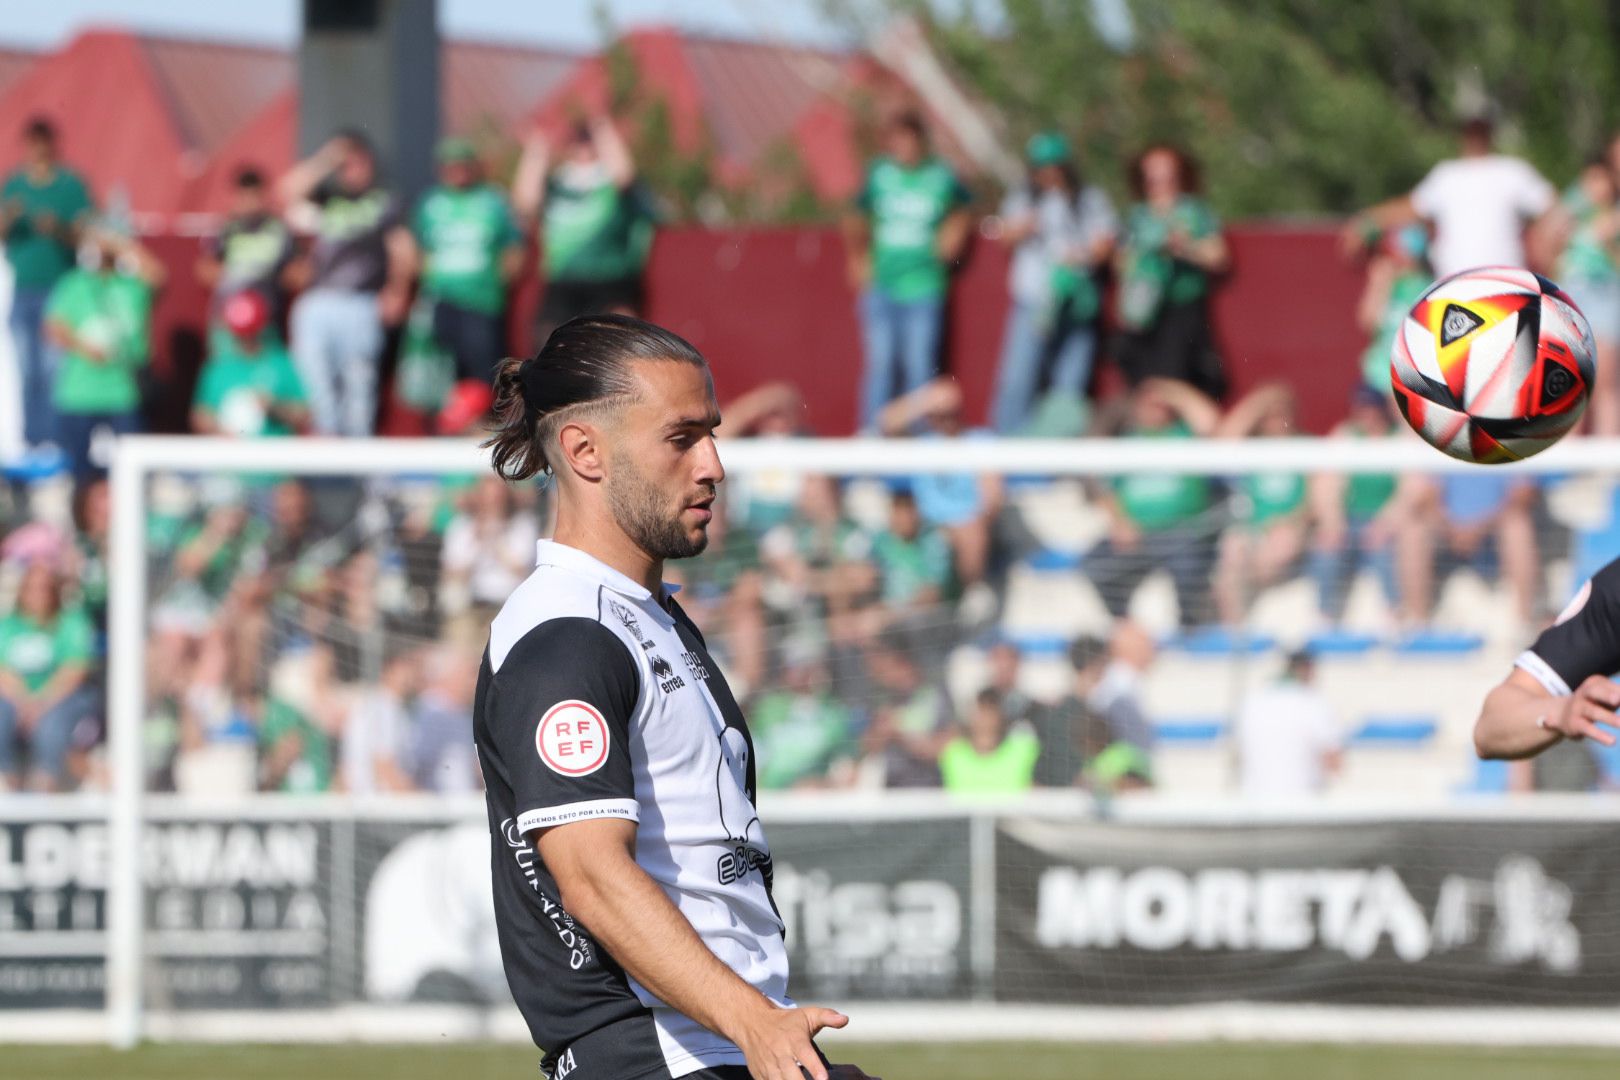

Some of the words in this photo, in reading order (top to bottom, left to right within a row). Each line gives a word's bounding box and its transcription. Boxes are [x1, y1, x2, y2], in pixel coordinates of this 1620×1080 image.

[523, 816, 557, 827] HACEMOS
[559, 812, 577, 821] ESTO
[579, 809, 593, 817] POR
[607, 807, 629, 815] UNIÓN
[1036, 866, 1432, 962] MORETA
